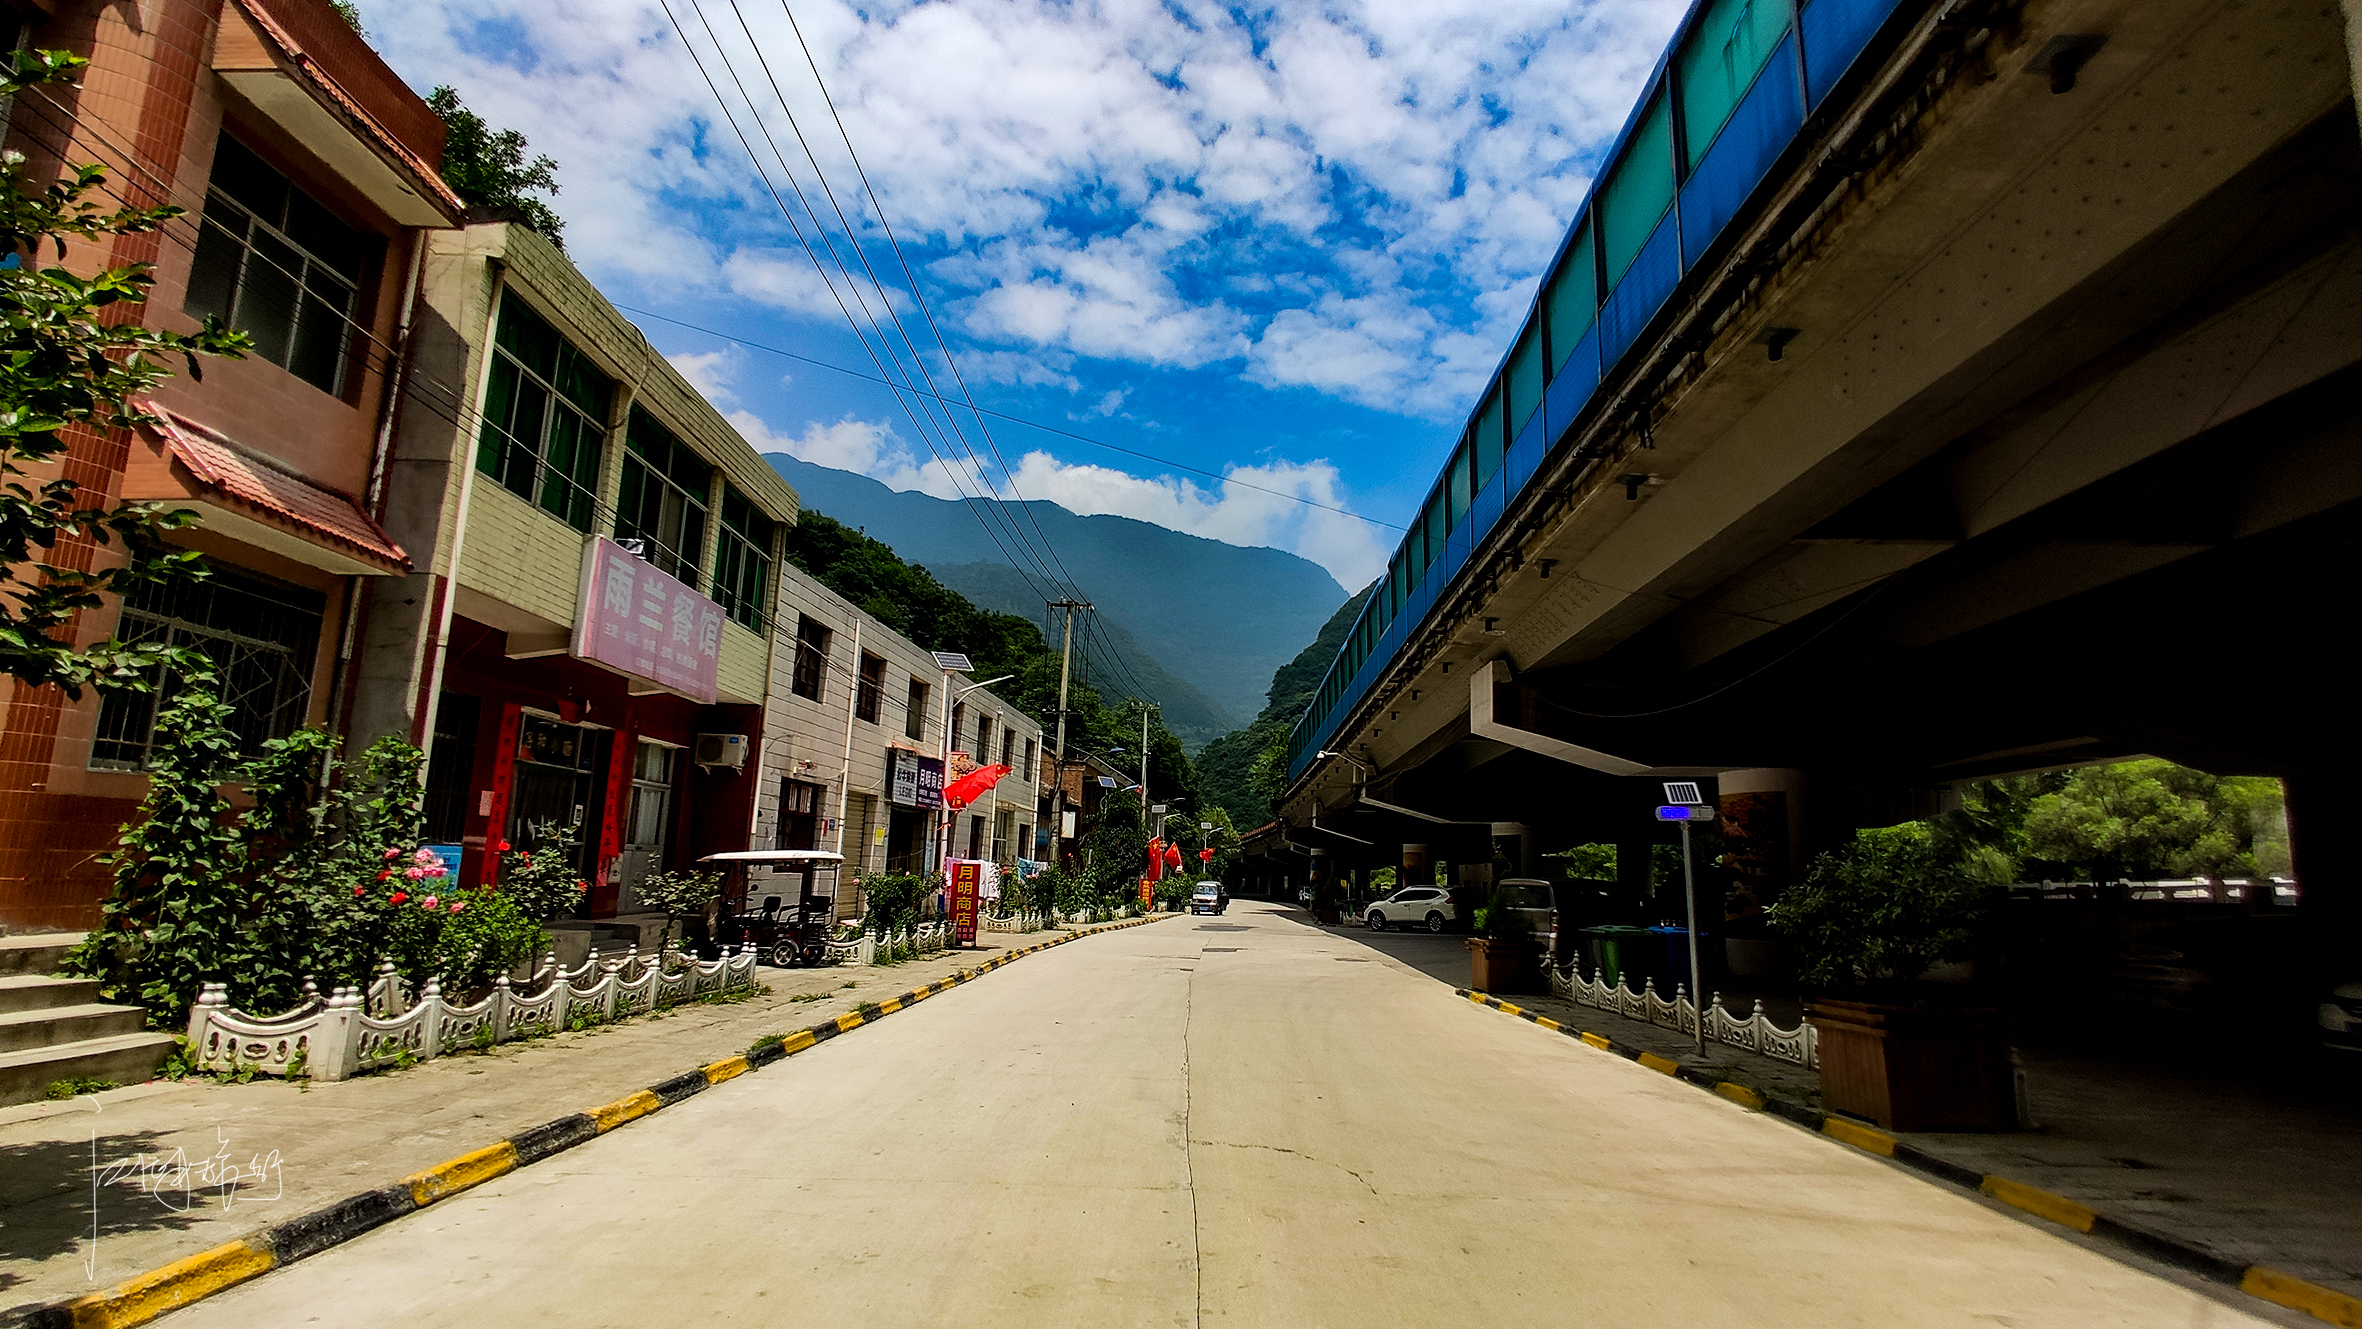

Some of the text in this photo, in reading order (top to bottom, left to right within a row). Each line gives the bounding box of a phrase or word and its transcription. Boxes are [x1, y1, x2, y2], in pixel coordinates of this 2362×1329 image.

[604, 555, 721, 659] 雨兰餐馆
[955, 865, 974, 927] 月明商店
